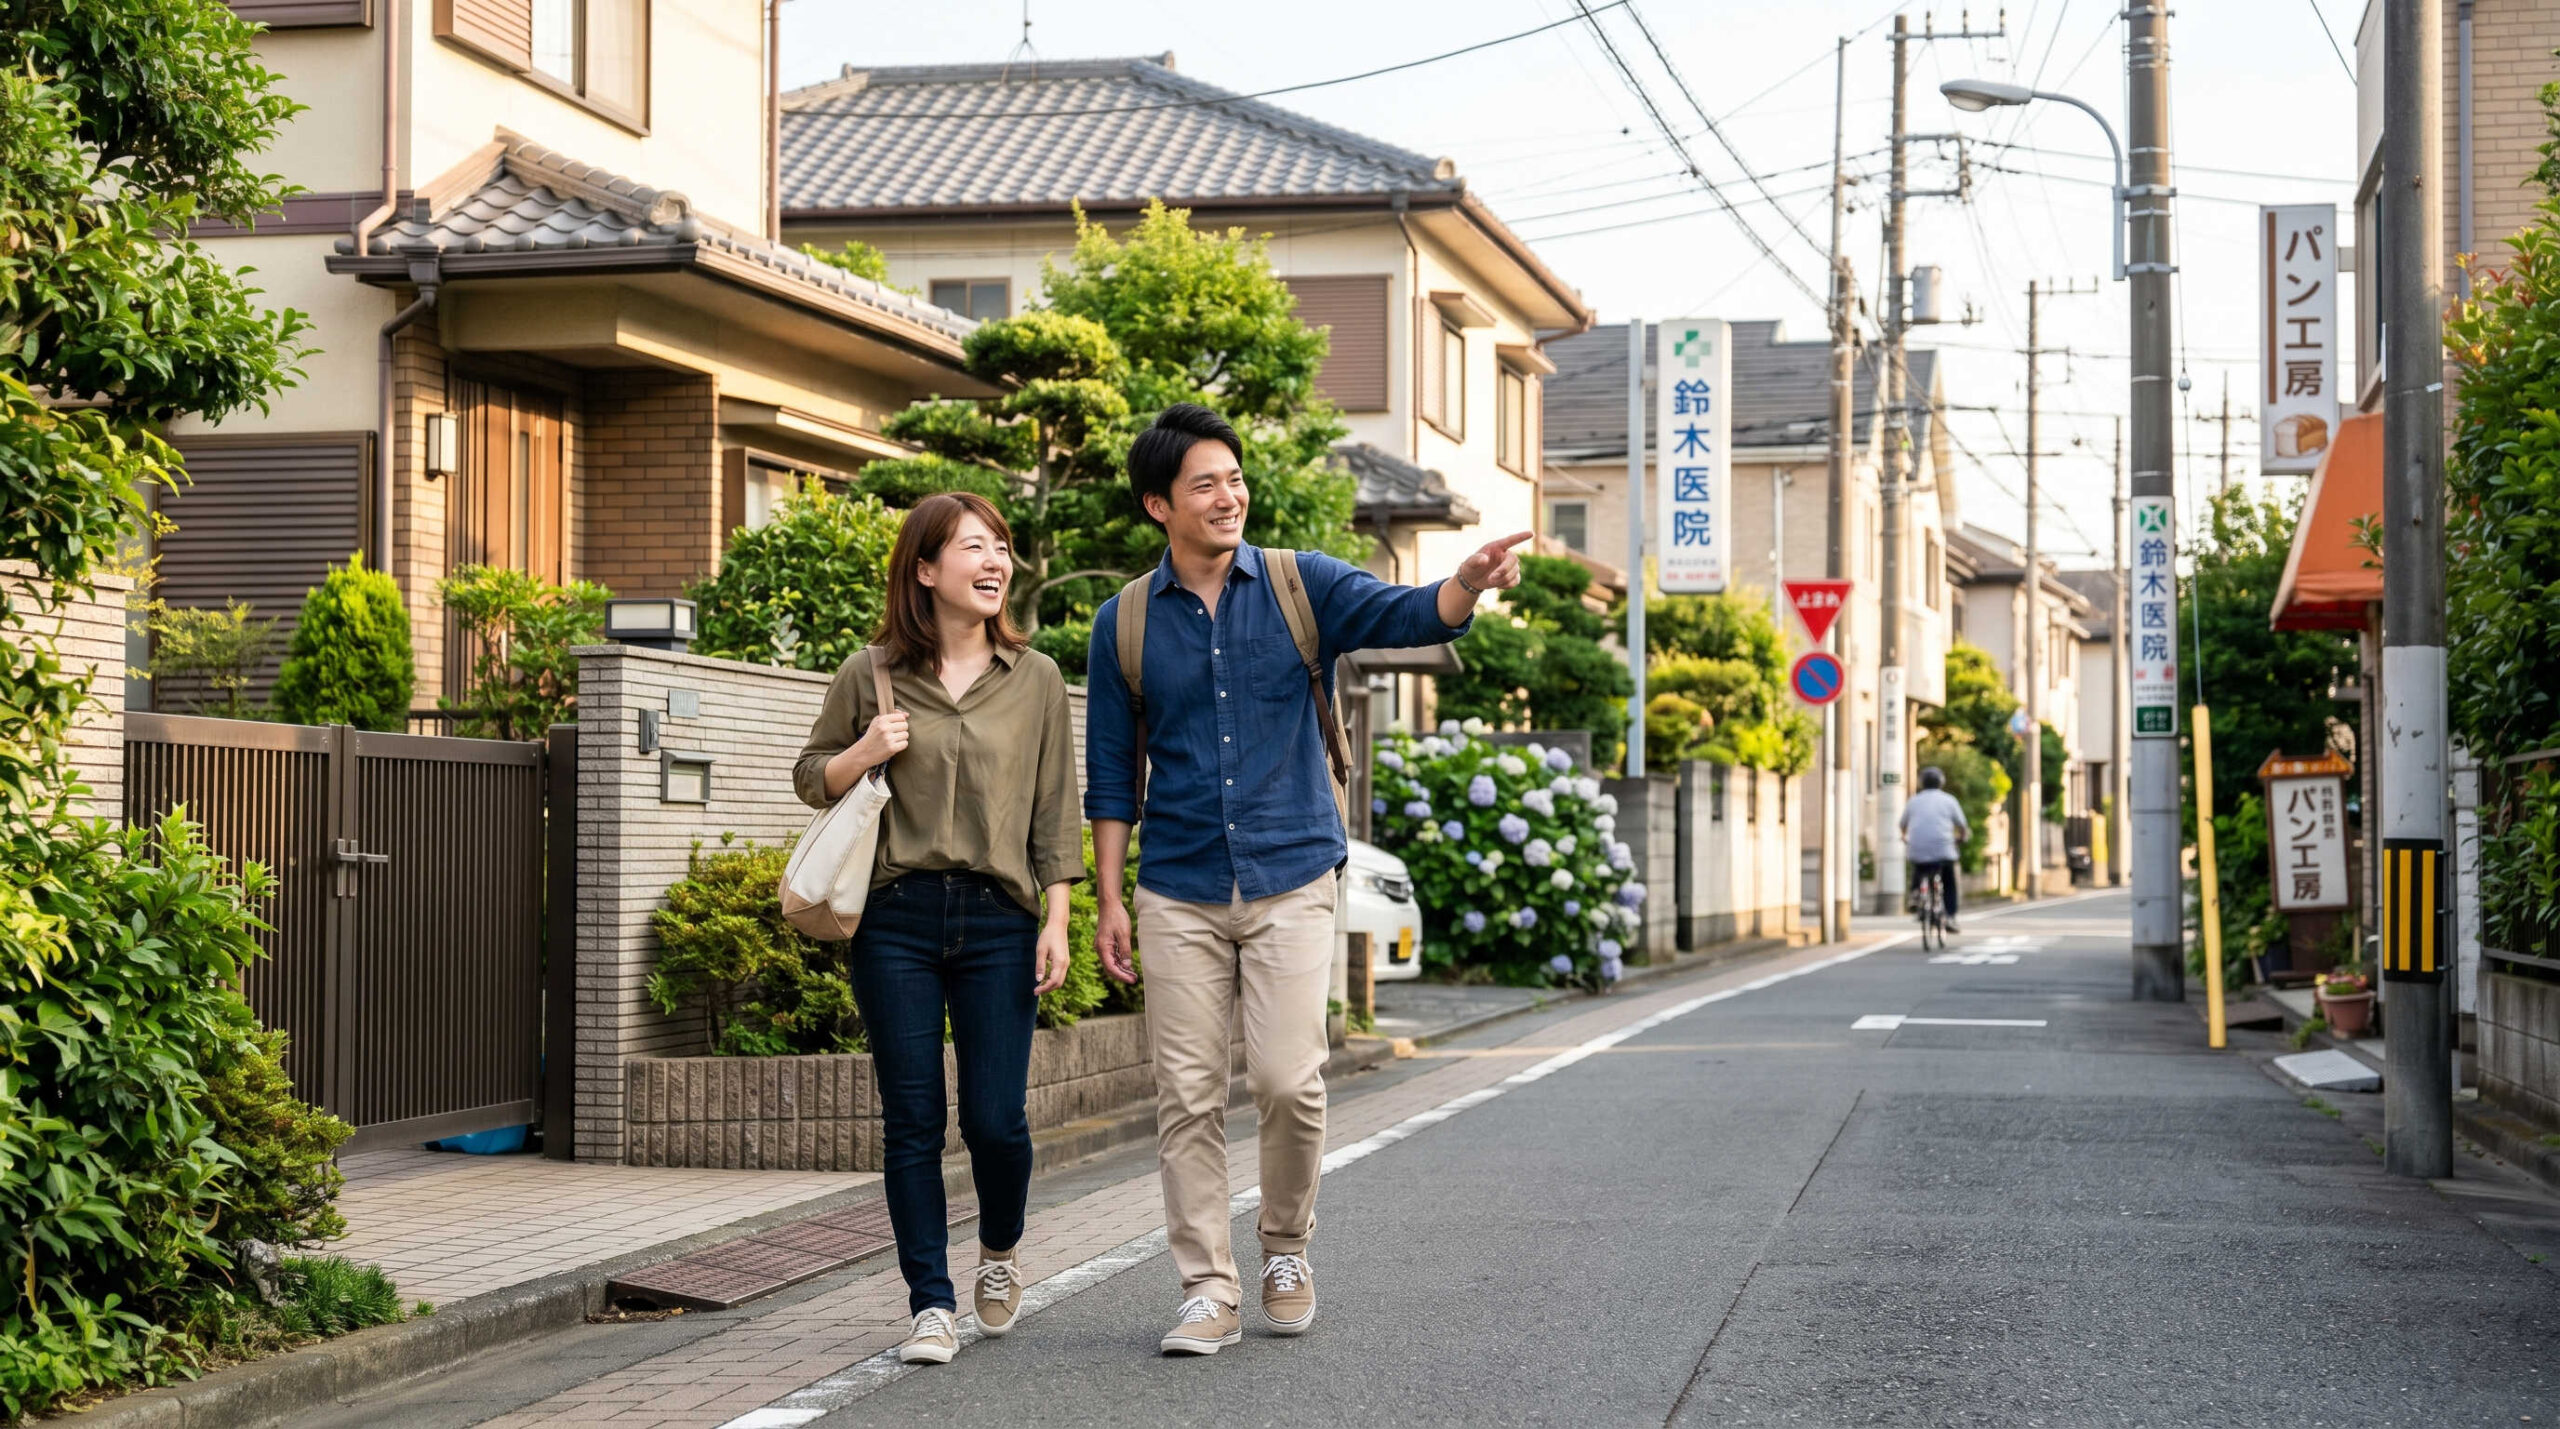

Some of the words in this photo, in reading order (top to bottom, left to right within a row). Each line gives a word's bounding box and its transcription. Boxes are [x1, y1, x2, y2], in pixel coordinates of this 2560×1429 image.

[2284, 225, 2323, 396] パン工房
[1673, 378, 1711, 546] 鈴木医院
[2140, 538, 2168, 661] 鈴木医院
[2287, 786, 2322, 900] パン工房
